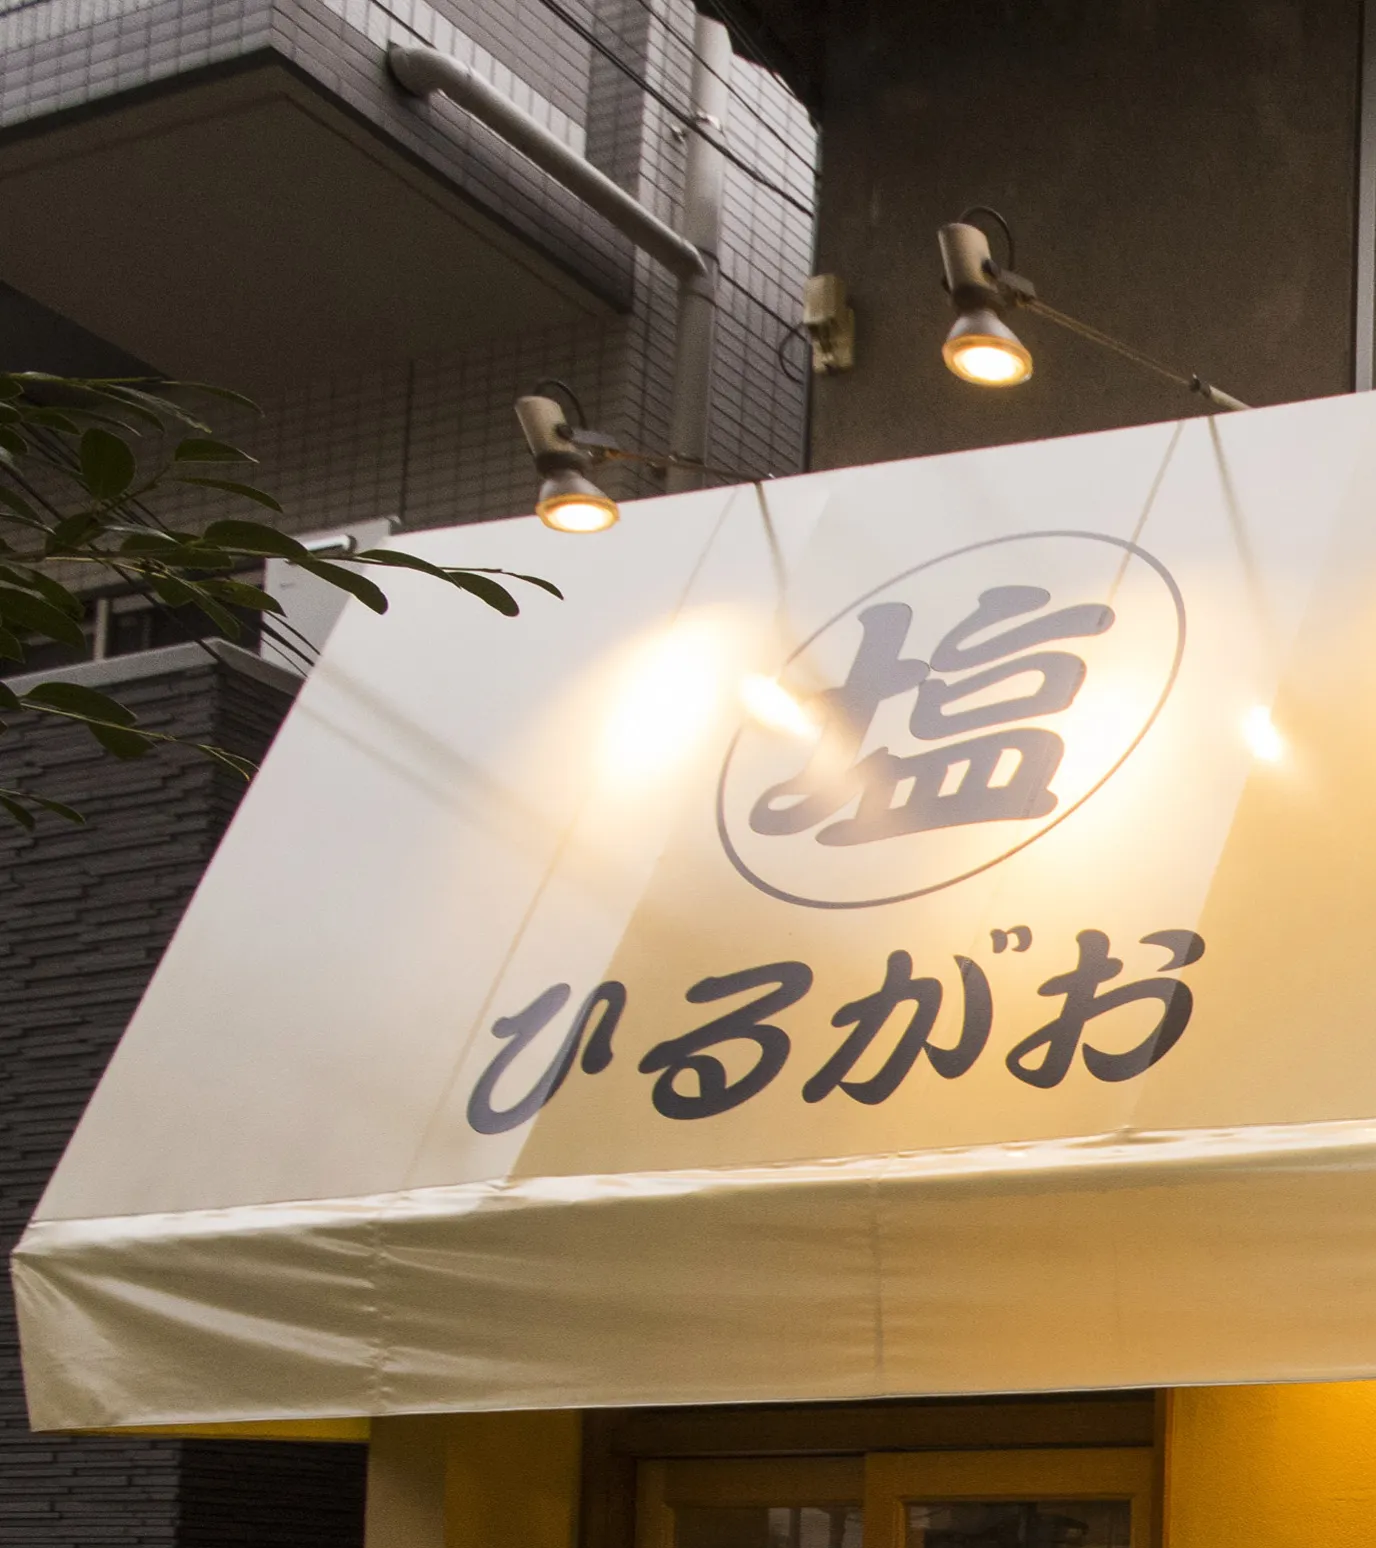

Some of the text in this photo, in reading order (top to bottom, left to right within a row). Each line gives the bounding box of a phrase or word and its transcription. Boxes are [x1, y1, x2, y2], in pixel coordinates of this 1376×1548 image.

[749, 586, 1114, 846] 塩
[467, 926, 1206, 1135] ひるがお
